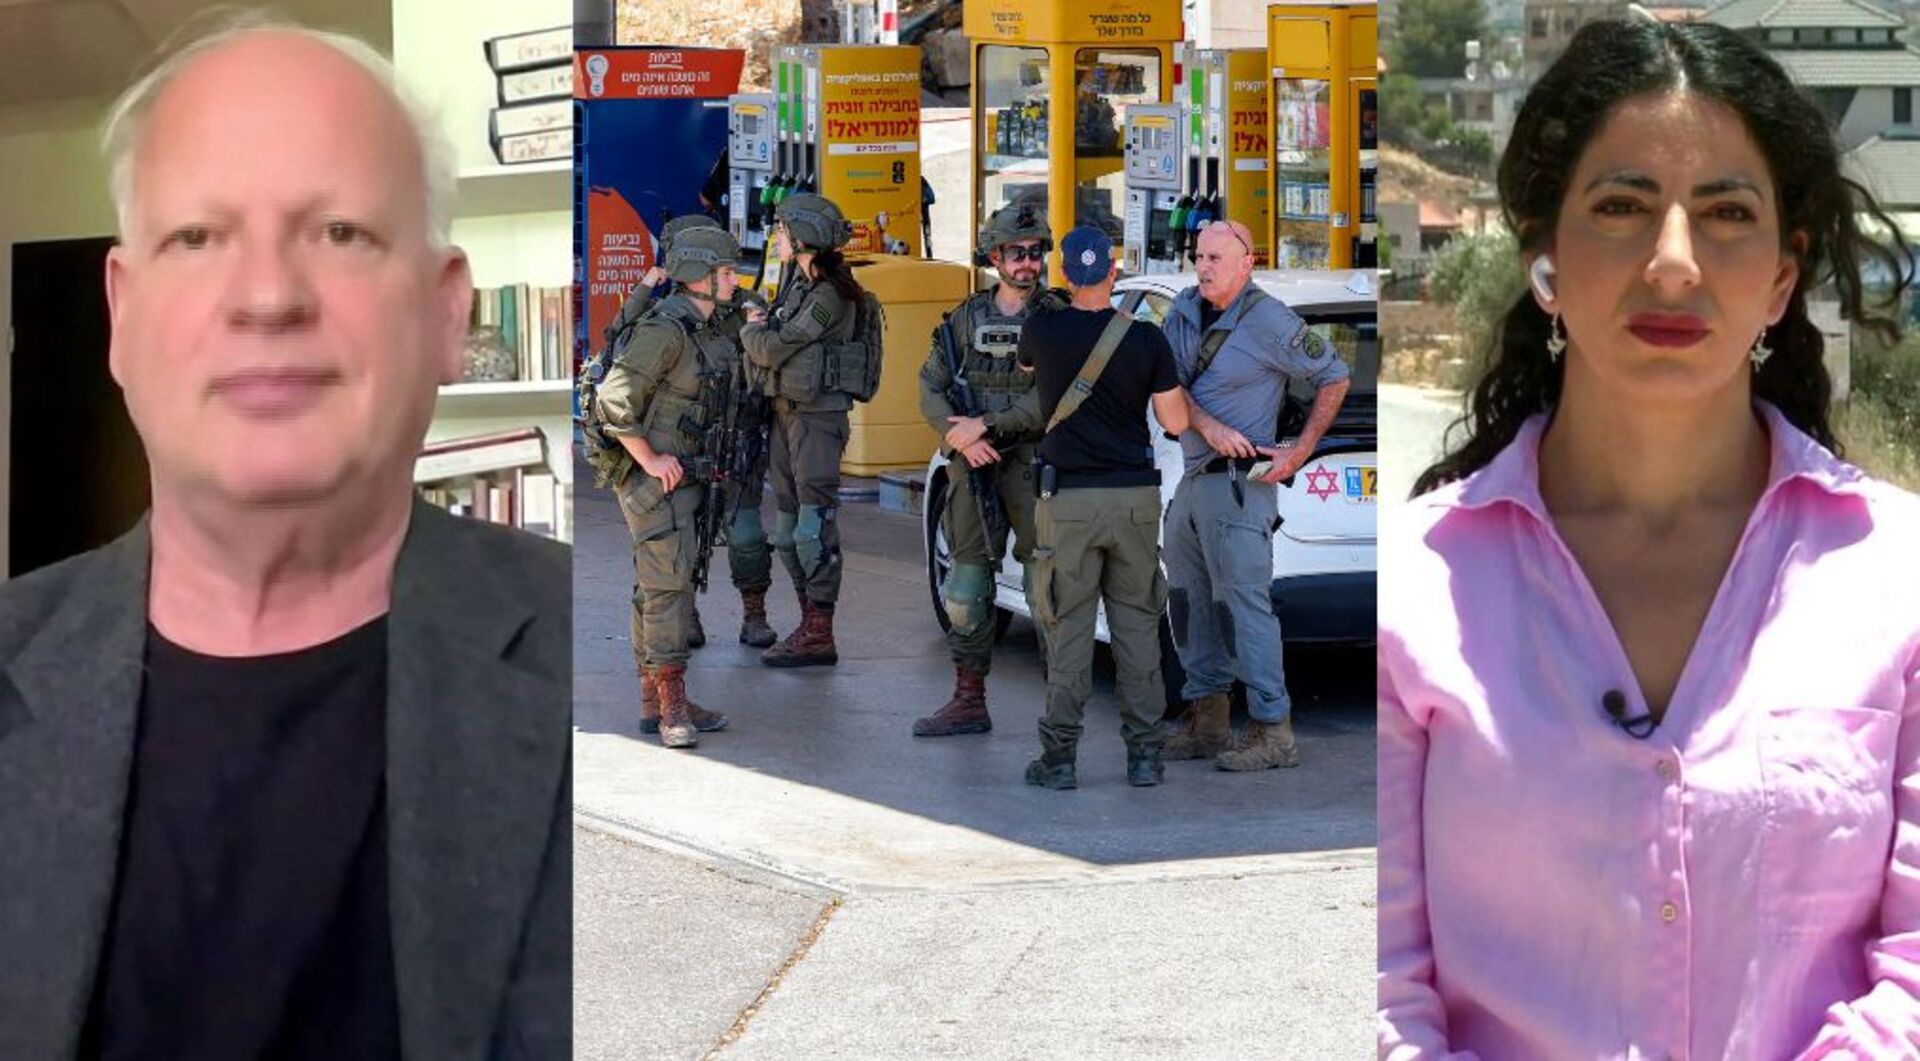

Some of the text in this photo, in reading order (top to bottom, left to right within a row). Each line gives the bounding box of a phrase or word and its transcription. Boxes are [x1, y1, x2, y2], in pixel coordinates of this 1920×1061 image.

[621, 72, 641, 82] מים
[671, 85, 695, 95] אתם
[826, 98, 918, 114] בחבילה זוגית
[1233, 111, 1267, 125] וגית
[828, 117, 918, 138] למונדיאל!
[602, 233, 640, 246] נביעות
[632, 255, 646, 266] זה
[597, 269, 619, 281] מים
